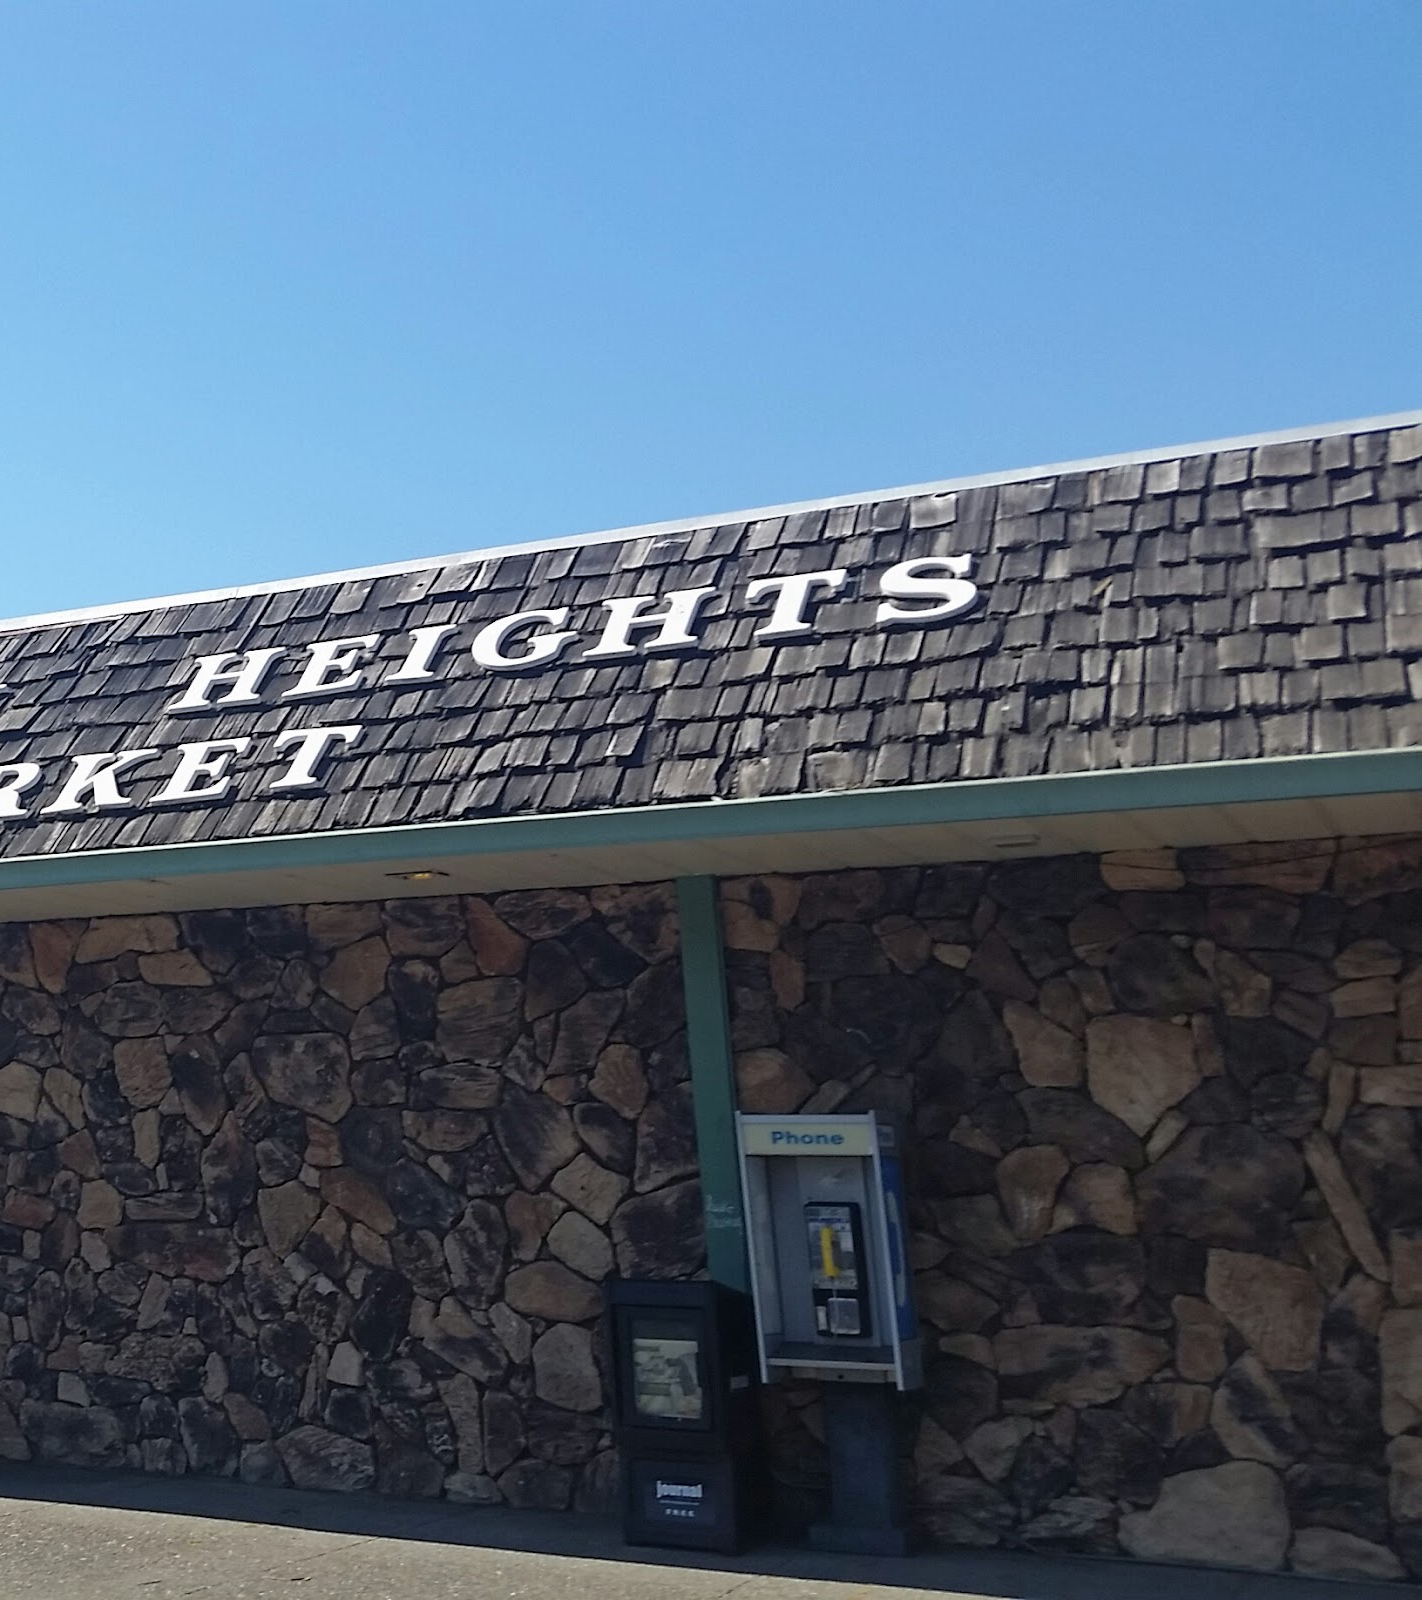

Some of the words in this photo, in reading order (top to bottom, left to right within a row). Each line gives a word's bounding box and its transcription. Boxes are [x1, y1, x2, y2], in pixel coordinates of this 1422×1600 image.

[169, 555, 979, 715] HEIGHTS
[770, 1130, 845, 1146] Phone
[665, 1508, 696, 1518] FREE
